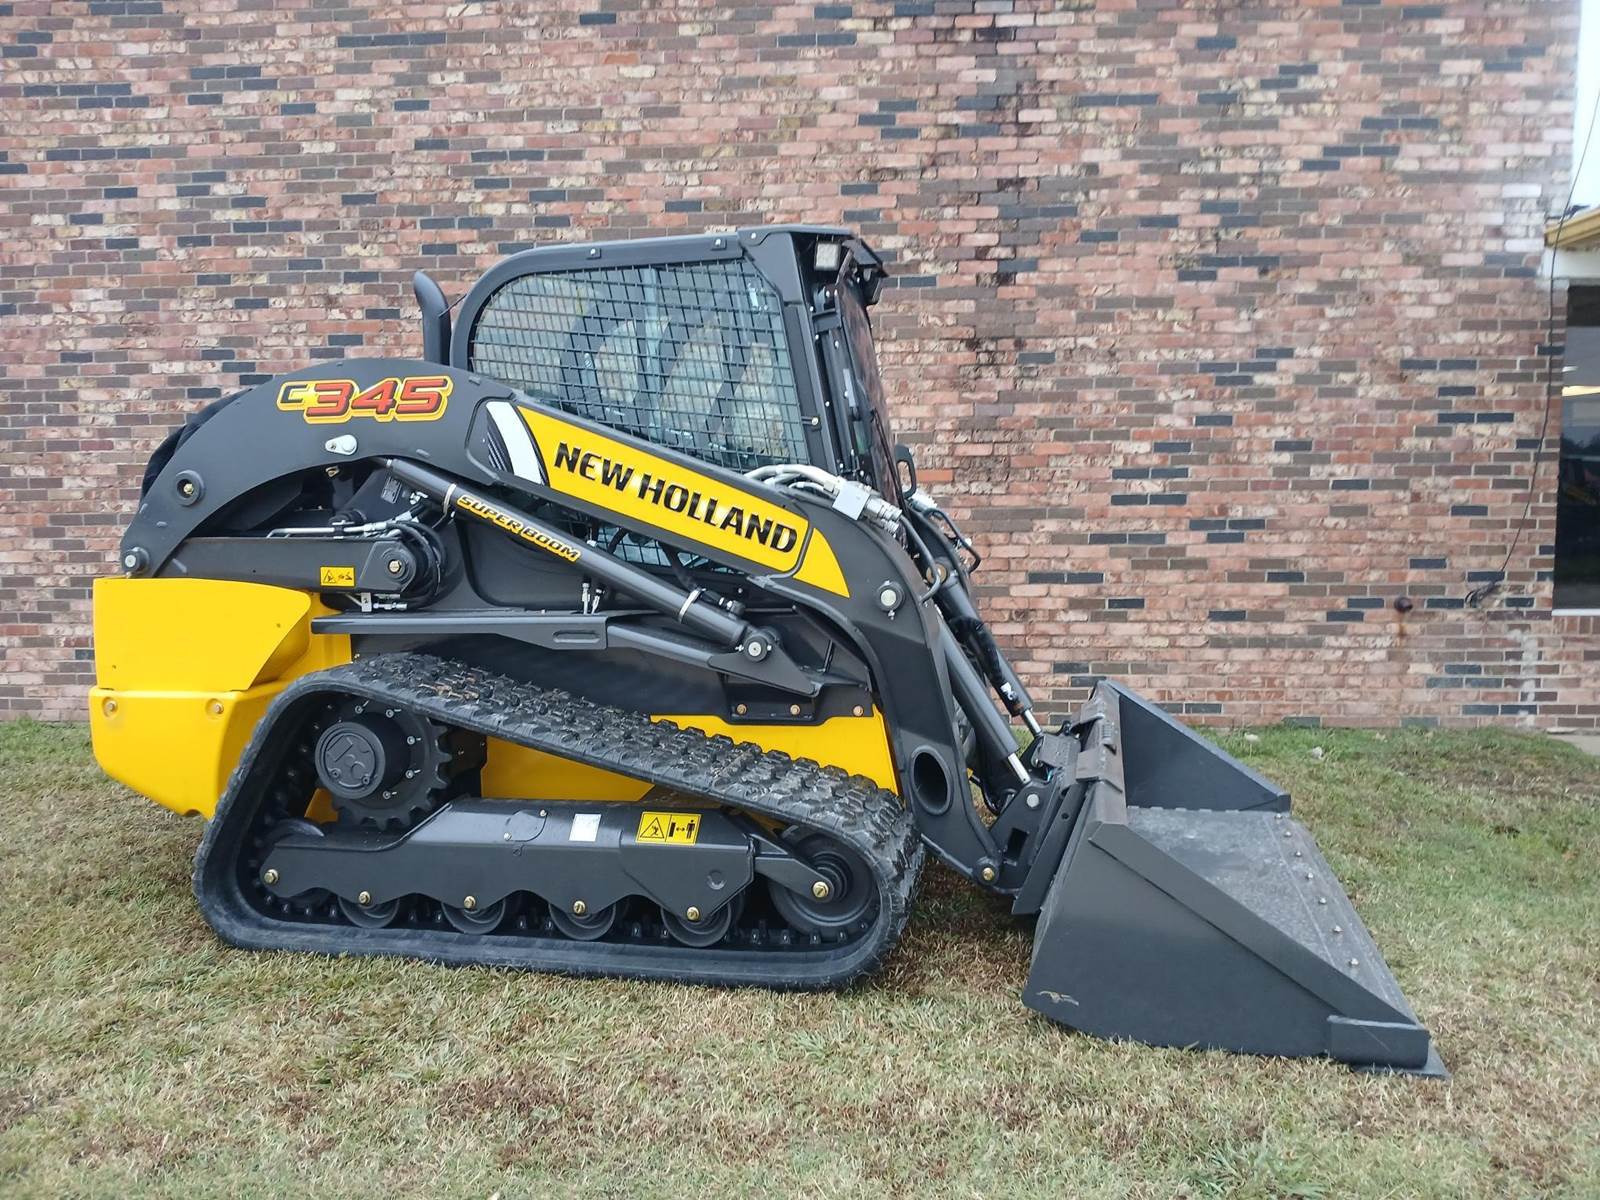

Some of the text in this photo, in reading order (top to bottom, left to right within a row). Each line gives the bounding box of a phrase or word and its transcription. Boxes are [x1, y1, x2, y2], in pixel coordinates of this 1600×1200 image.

[278, 376, 452, 423] C345
[458, 495, 580, 561] SUPER BOOM
[554, 442, 798, 553] NEW HOLLAND
